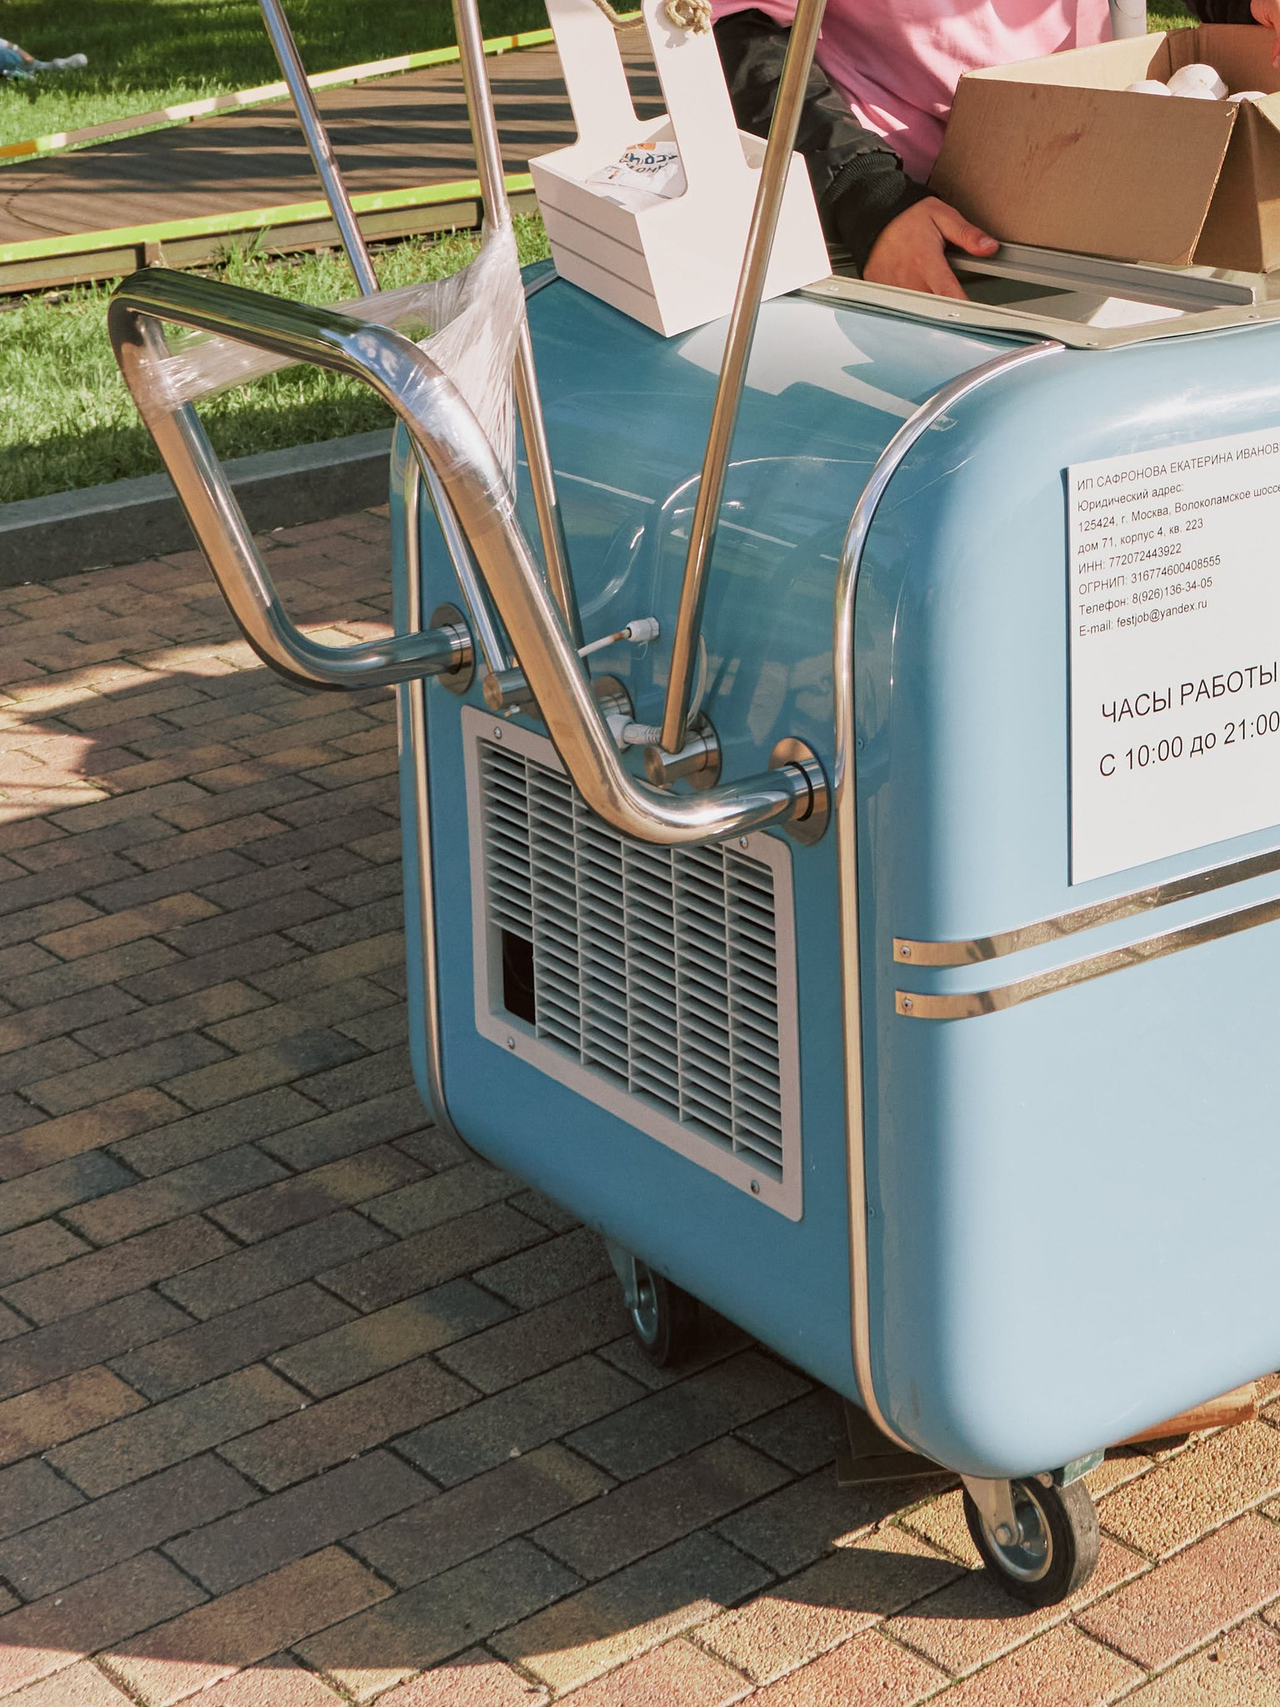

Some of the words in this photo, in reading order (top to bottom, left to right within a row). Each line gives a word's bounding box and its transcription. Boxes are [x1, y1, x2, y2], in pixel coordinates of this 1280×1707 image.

[1077, 477, 1094, 491] ИП
[1096, 466, 1167, 489] САФРОНОВА
[1170, 454, 1234, 474] ЕКАТЕРИНА
[1077, 489, 1149, 513] Юридический
[1151, 483, 1184, 500] адрес:
[1079, 516, 1119, 533] 125424,
[1121, 514, 1128, 524] г.
[1131, 505, 1171, 522] Москва,
[1174, 490, 1251, 514] Волоколамское
[1077, 540, 1099, 555] дом
[1102, 536, 1117, 549] 71,
[1120, 529, 1155, 546] корпус
[1157, 526, 1166, 537] 4,
[1169, 524, 1182, 535] кв.
[1185, 518, 1204, 532] 223
[1078, 560, 1106, 574] ИНН:
[1109, 543, 1182, 568] 772072443922
[1078, 574, 1128, 596] ОГРНИП:
[1131, 554, 1221, 585] 316774600408555
[1079, 597, 1129, 616] Телефон:
[1132, 576, 1213, 604] 8(926)136-34-05
[1079, 619, 1113, 637] E-mail:
[1116, 599, 1208, 629] festjob@yandex.ru
[1101, 687, 1172, 723] ЧАСЫ
[1180, 661, 1278, 706] РАБОТЫ
[1099, 753, 1116, 777] С
[1125, 735, 1183, 770] 10:00
[1190, 732, 1217, 758] до
[1223, 710, 1280, 745] 21:00
